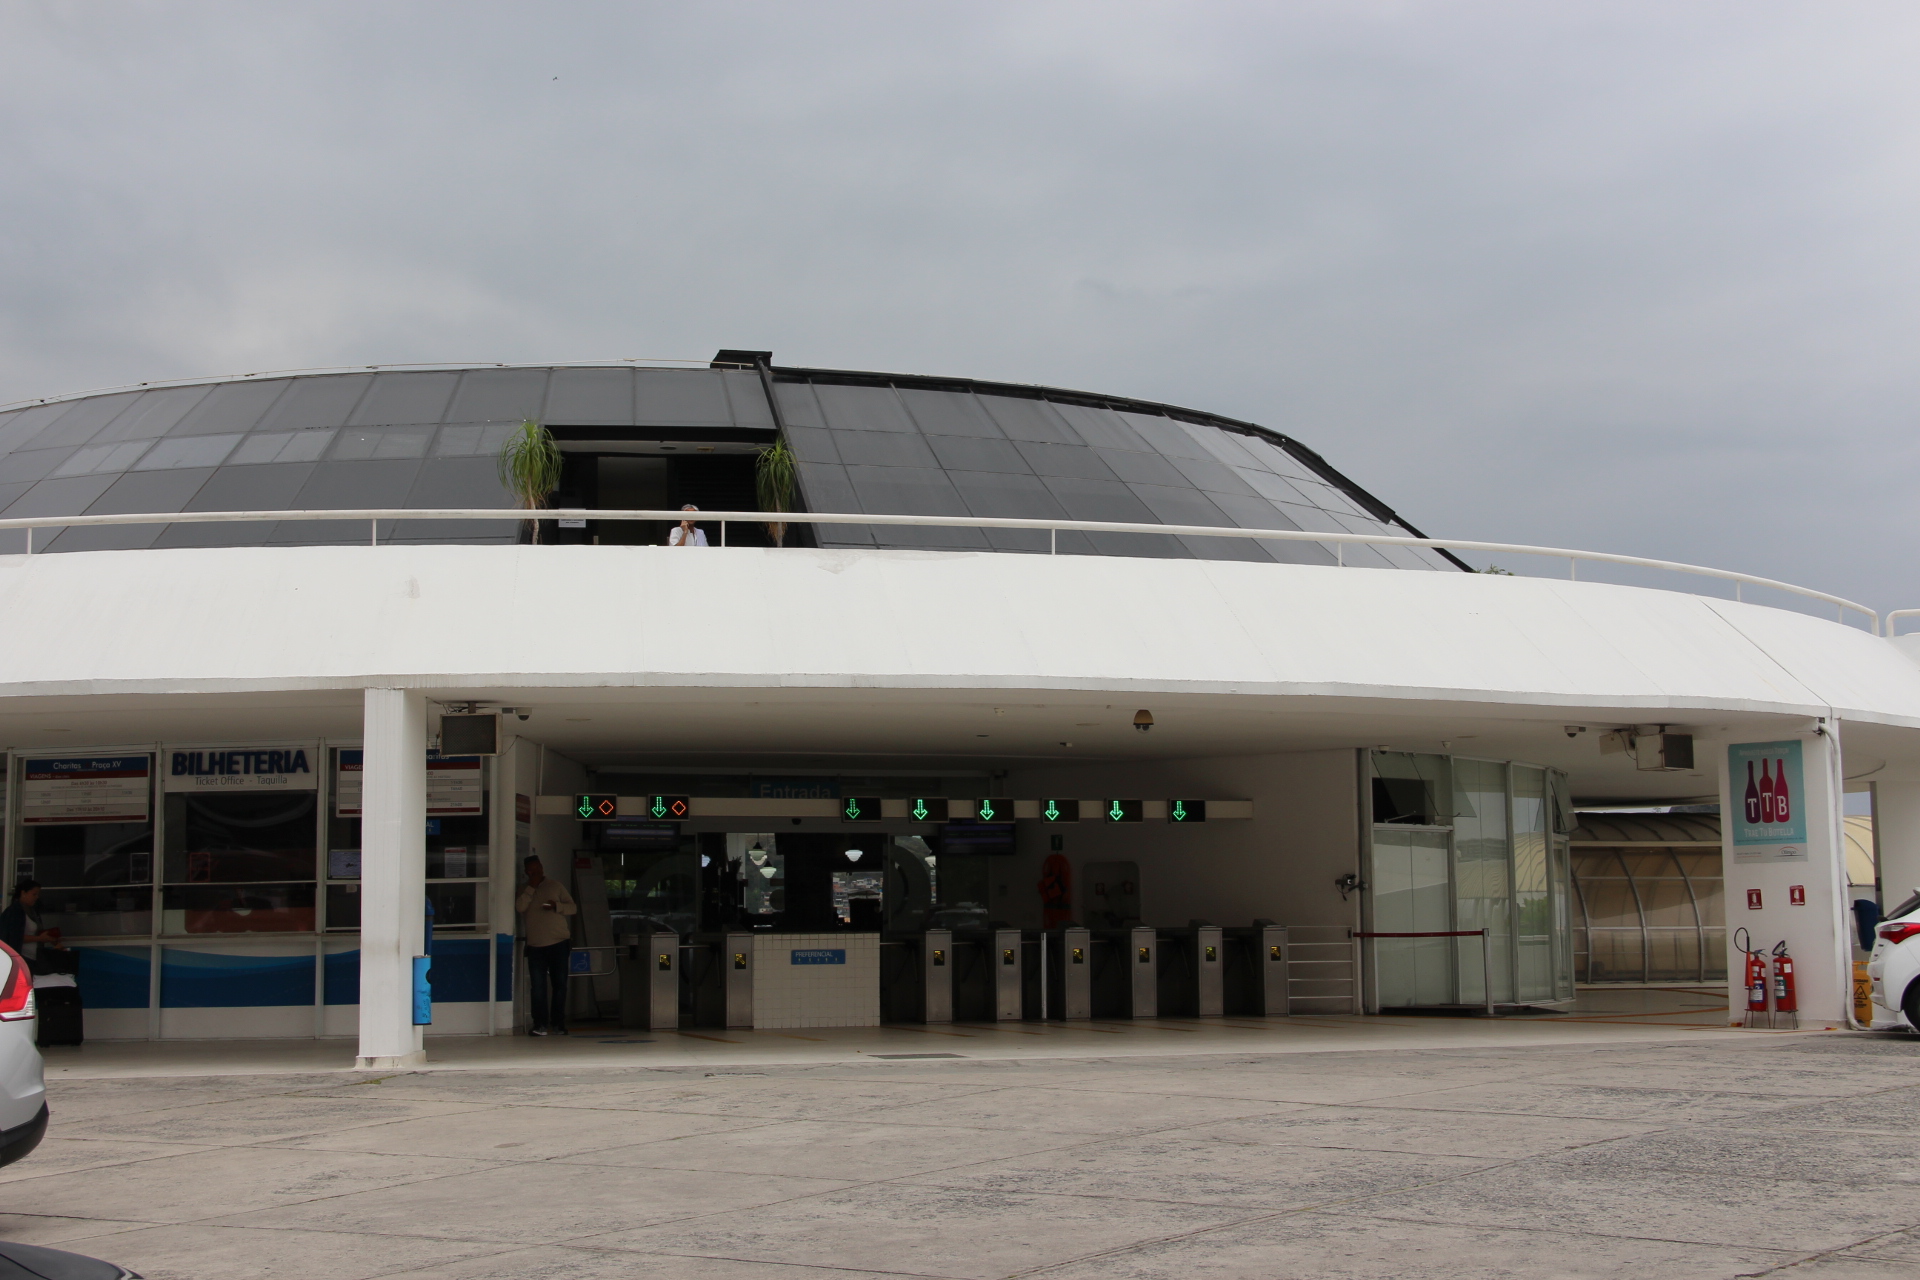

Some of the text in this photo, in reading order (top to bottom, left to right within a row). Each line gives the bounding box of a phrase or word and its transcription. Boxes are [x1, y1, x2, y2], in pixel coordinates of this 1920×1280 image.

[52, 762, 81, 770] Charitas
[91, 761, 110, 770] Praça
[172, 750, 310, 776] BILHETERIA
[195, 776, 218, 786] Ticket
[220, 776, 244, 786] Office
[257, 775, 287, 786] Taquilla
[760, 784, 831, 799] Entrada
[1747, 792, 1787, 818] T T B
